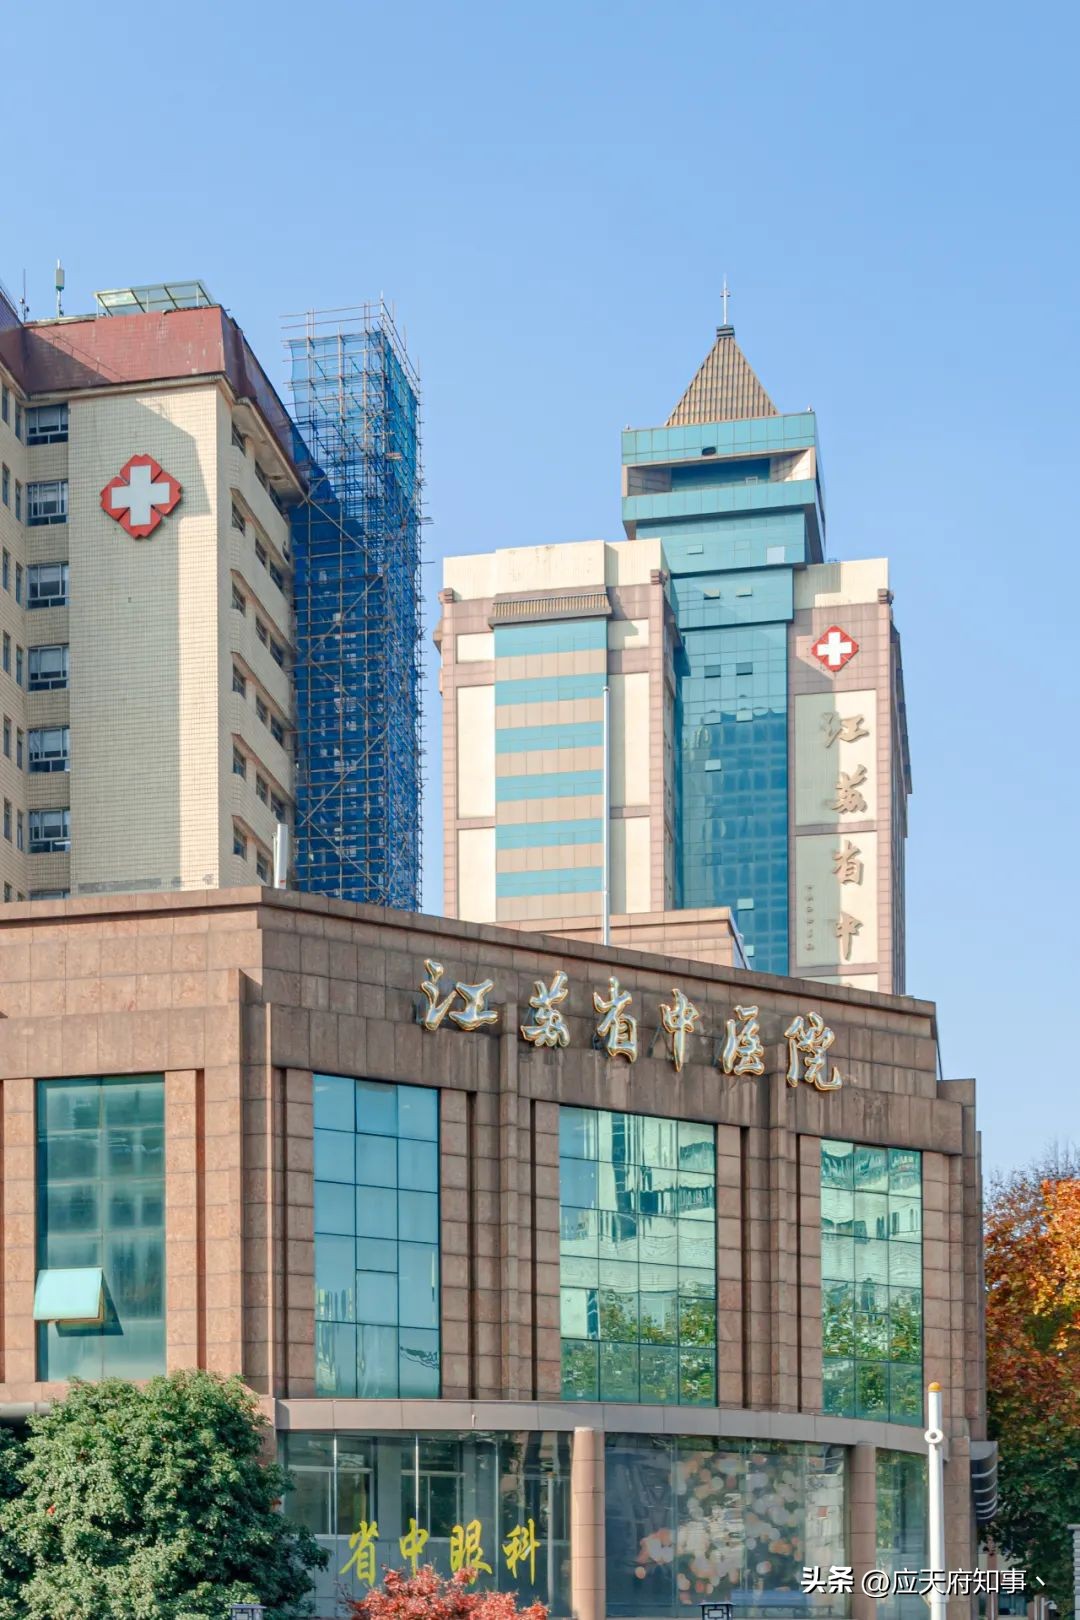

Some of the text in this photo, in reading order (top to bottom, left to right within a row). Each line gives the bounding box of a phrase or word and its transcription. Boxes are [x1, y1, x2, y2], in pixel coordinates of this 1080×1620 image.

[420, 958, 843, 1091] 江苏省中医院
[339, 1517, 541, 1586] 省中眼科
